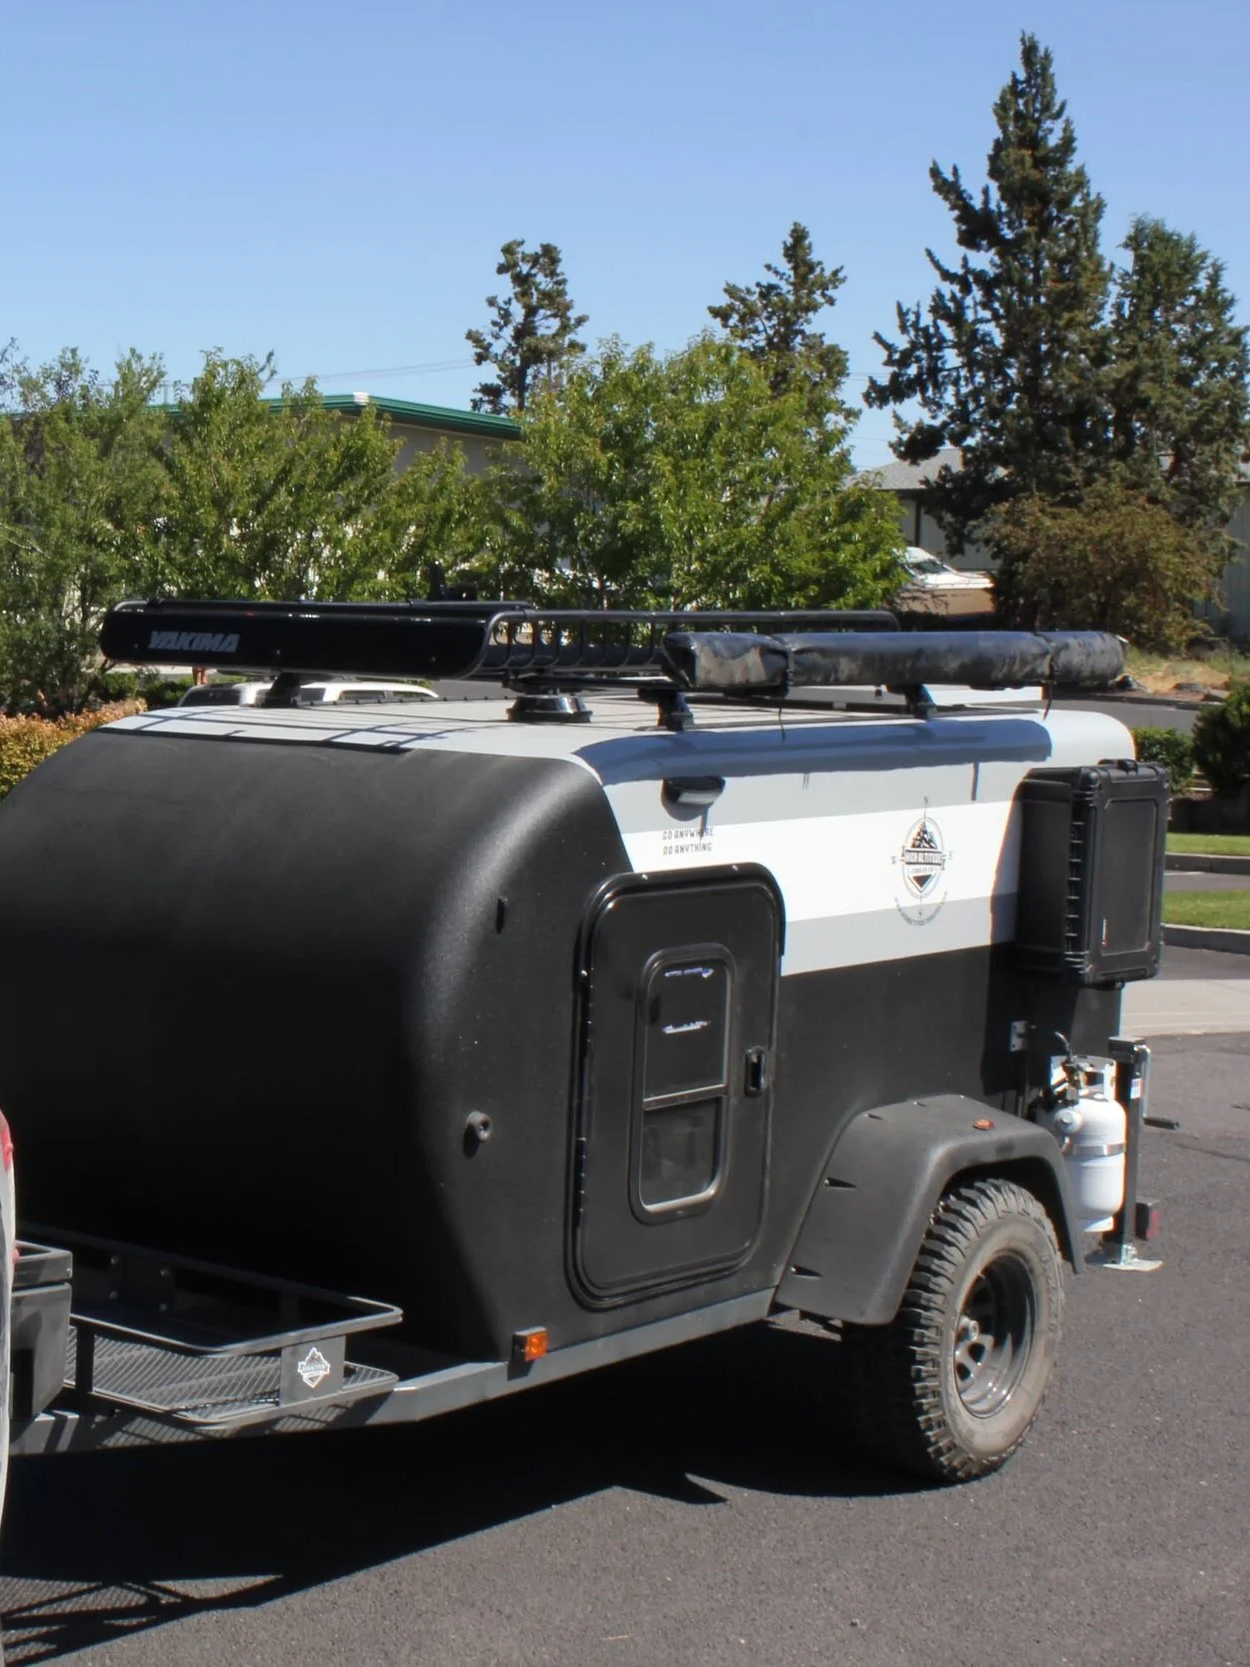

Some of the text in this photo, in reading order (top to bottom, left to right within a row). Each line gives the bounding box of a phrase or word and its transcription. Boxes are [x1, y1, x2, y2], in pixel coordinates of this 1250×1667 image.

[148, 631, 240, 652] YAKIMA
[674, 826, 714, 839] ANYWHRE
[674, 842, 712, 854] ANYTHING
